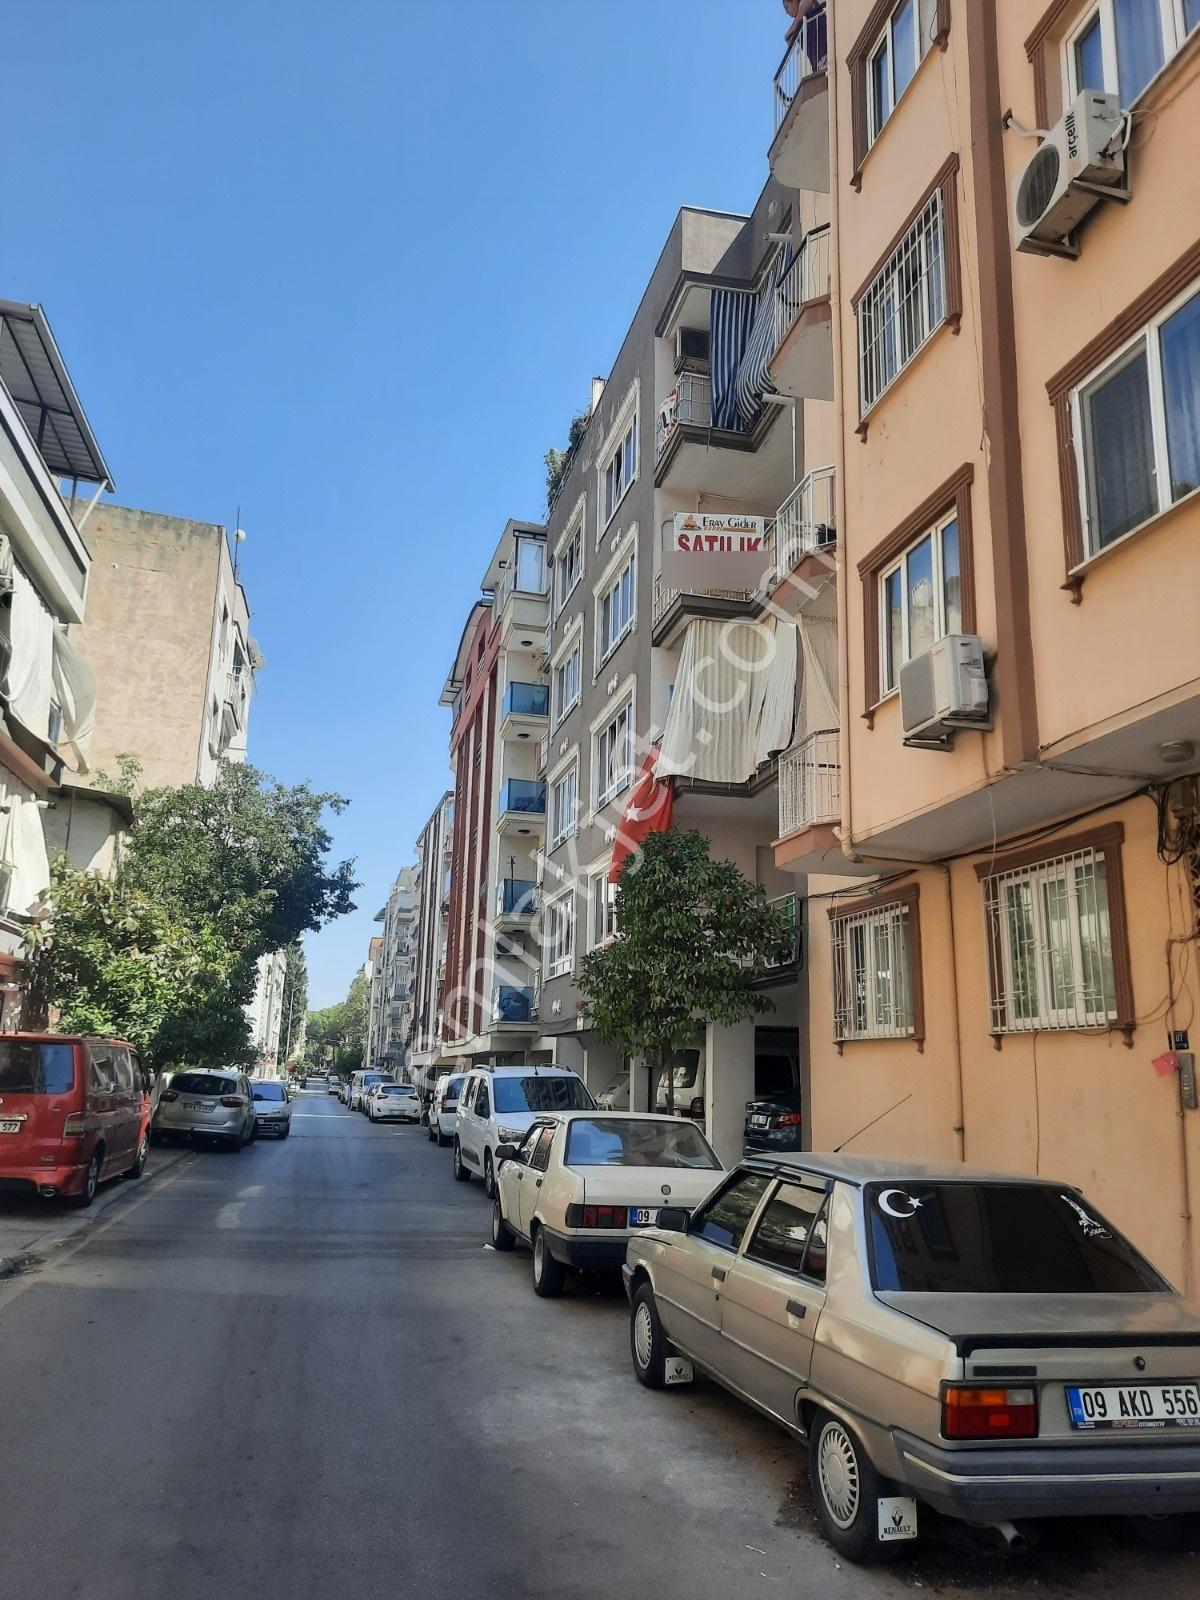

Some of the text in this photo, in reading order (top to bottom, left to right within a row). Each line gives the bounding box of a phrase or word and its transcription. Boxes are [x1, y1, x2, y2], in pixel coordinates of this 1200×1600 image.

[1064, 110, 1078, 159] arçelik
[2, 1123, 18, 1131] 577
[637, 1210, 650, 1222] 09
[1082, 1388, 1198, 1418] 09 AKD 556
[883, 1525, 911, 1534] RENAULT
